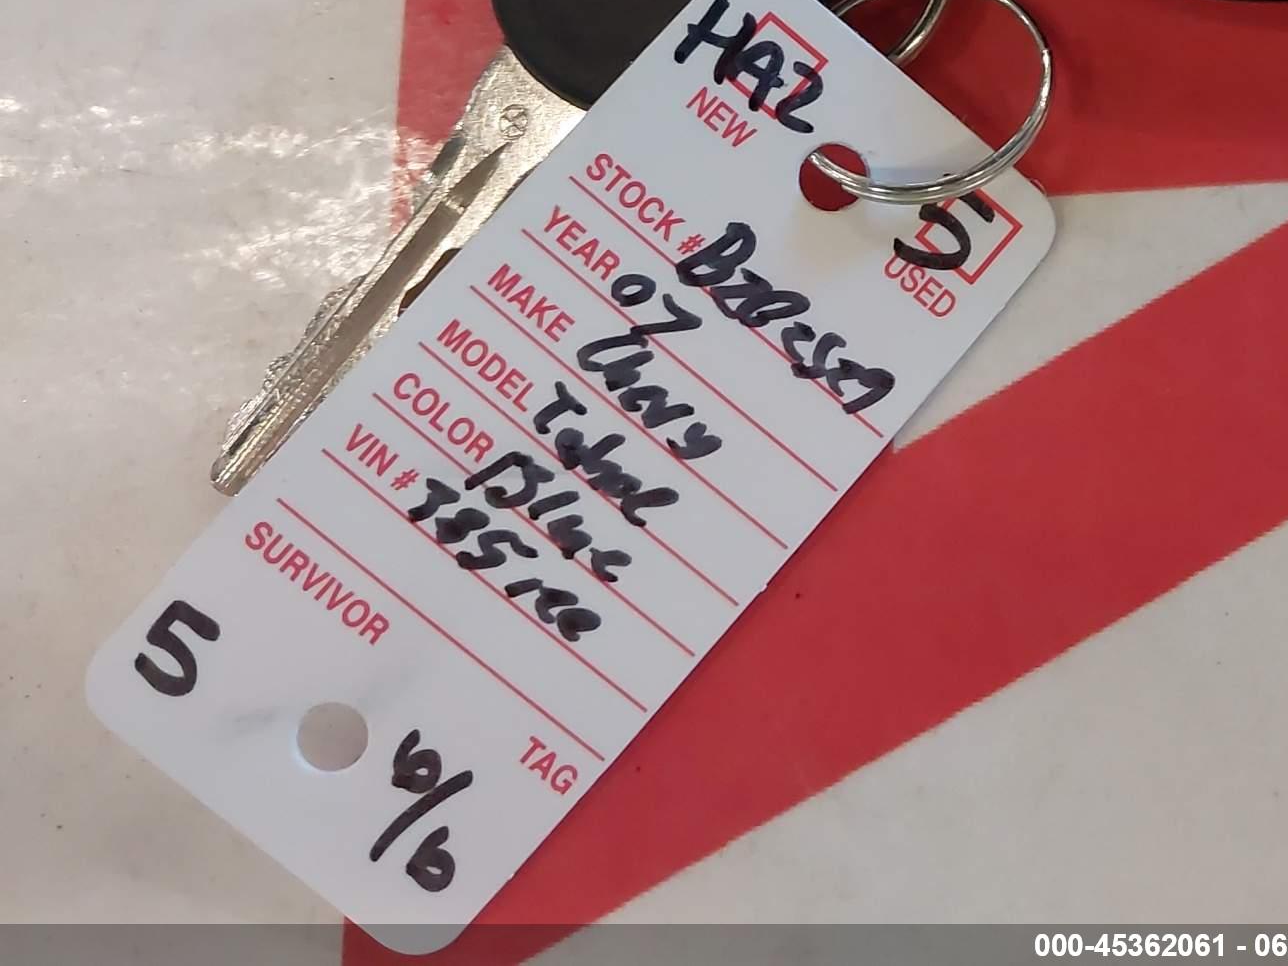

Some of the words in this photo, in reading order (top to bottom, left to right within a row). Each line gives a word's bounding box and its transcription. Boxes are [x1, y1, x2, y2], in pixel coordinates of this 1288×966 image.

[686, 87, 758, 148] NEW
[542, 205, 621, 281] YEAR
[585, 152, 687, 242] STOCK
[677, 233, 706, 255] #
[893, 172, 996, 270] 5
[487, 263, 576, 343] MAKE
[610, 272, 703, 336] 07
[883, 250, 957, 318] USED
[436, 319, 535, 413] MODEL
[345, 423, 400, 477] VIN
[389, 468, 421, 491] #
[393, 371, 495, 463] COLOR
[463, 450, 633, 583] Blue
[245, 520, 390, 646] SURVIVOR
[133, 599, 222, 698] 5
[517, 735, 580, 797] TAG
